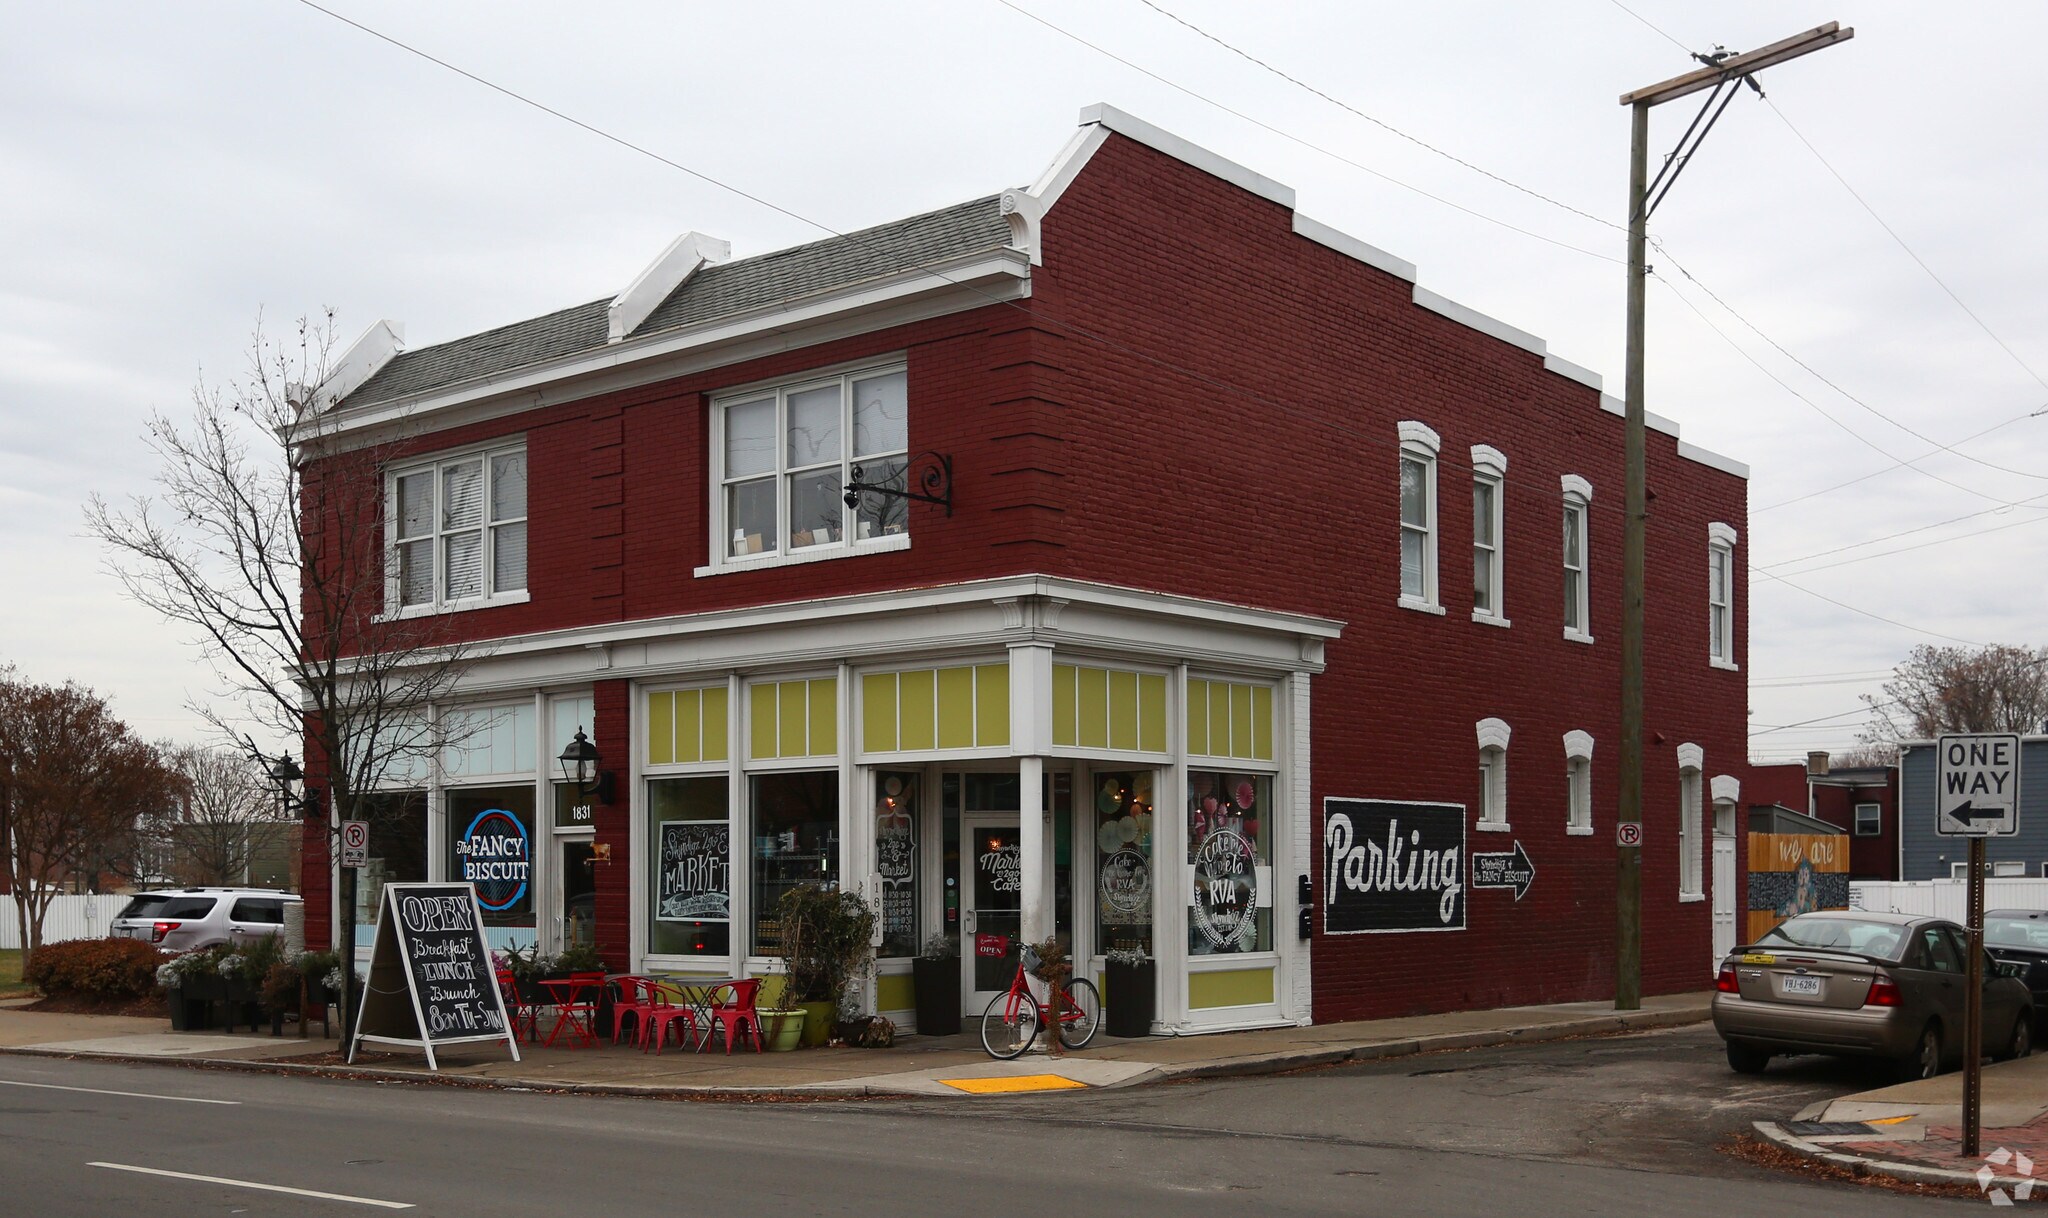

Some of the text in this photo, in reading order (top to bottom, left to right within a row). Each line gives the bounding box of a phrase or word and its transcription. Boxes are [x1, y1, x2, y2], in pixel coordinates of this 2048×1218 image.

[1948, 743, 2009, 767] ONE
[1946, 771, 2010, 794] WAY
[572, 805, 591, 820] 1831
[456, 835, 524, 858] The FANCY
[1780, 839, 1834, 864] we are
[465, 862, 529, 880] BISCUIT
[879, 861, 909, 877] Market
[980, 852, 1021, 873] Mark
[1326, 813, 1462, 924] Parking
[665, 850, 729, 900] MARKET
[1504, 871, 1530, 883] BISCUIT
[1209, 879, 1236, 906] RVA
[402, 896, 473, 932] OPEN
[412, 937, 475, 963] Breakfast
[980, 946, 1002, 954] OPEN
[422, 961, 476, 981] LUNCH
[430, 983, 480, 1001] Brunch
